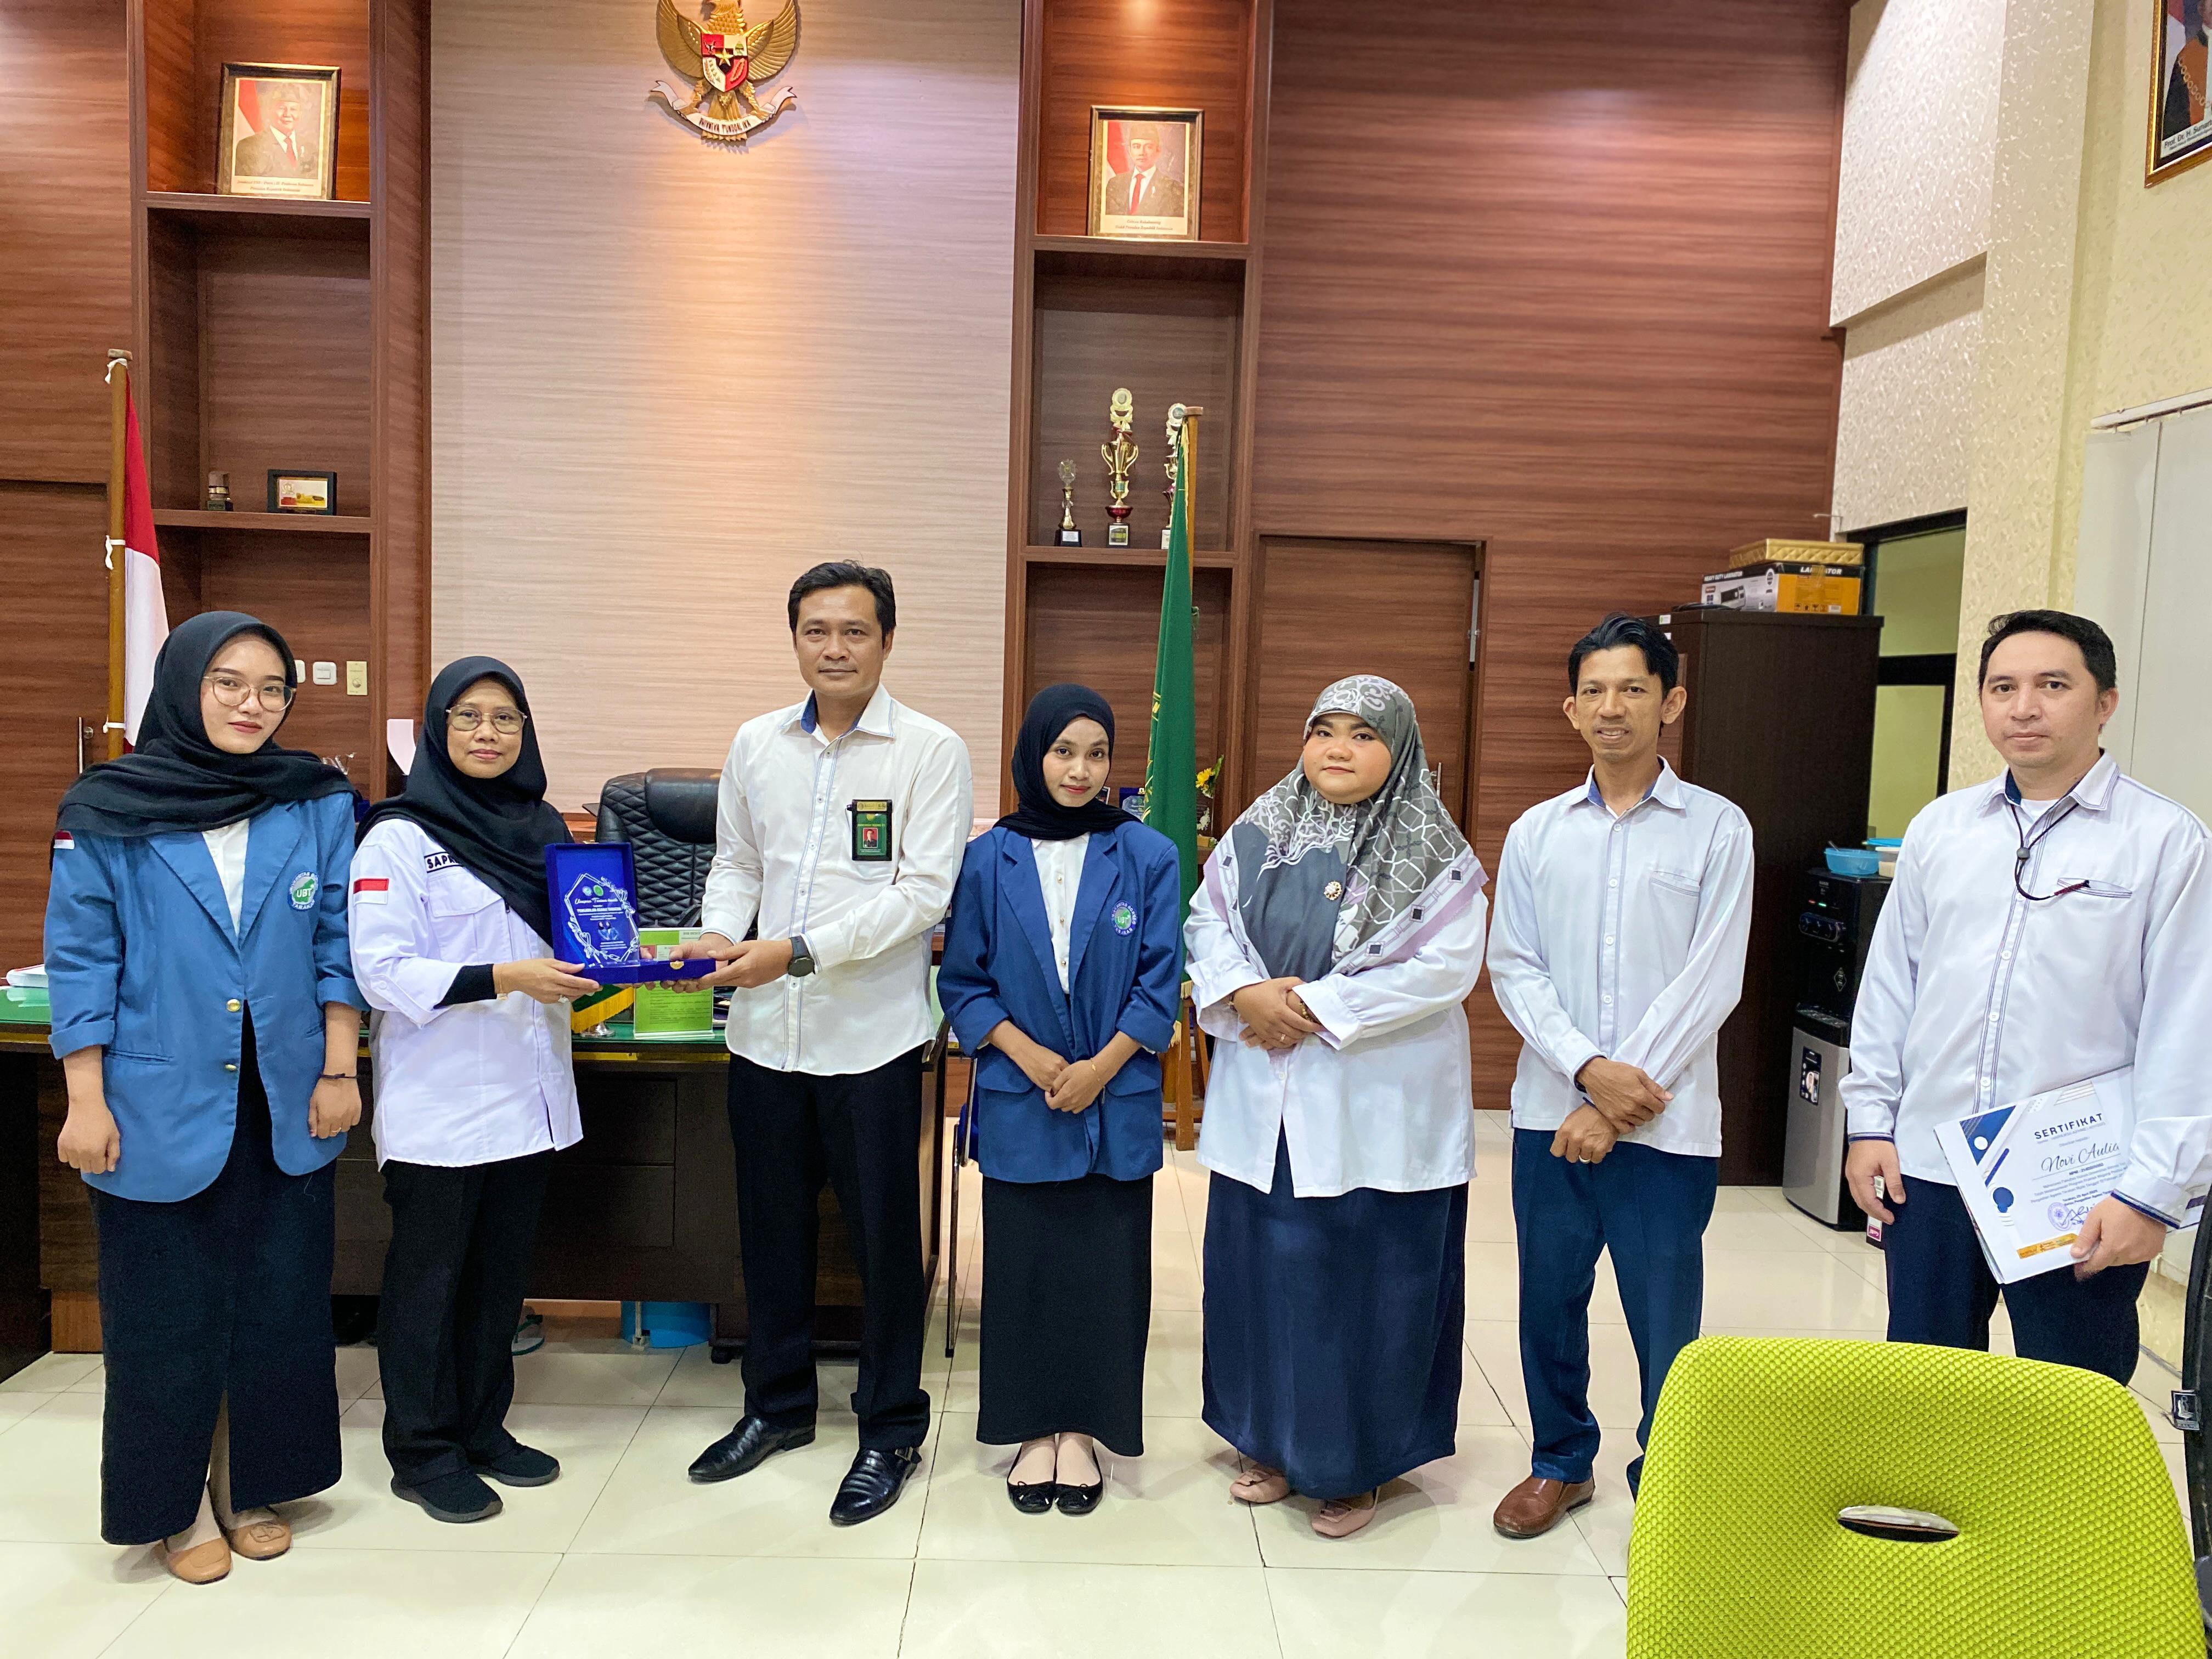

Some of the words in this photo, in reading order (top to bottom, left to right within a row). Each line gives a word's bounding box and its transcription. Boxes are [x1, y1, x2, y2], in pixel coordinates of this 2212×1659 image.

[1800, 566, 1842, 575] LAATOR
[297, 888, 312, 898] UBT
[2034, 1113, 2102, 1139] SERTIFIKAT
[2041, 1154, 2075, 1172] Novi
[2078, 1143, 2119, 1163] Aulia
